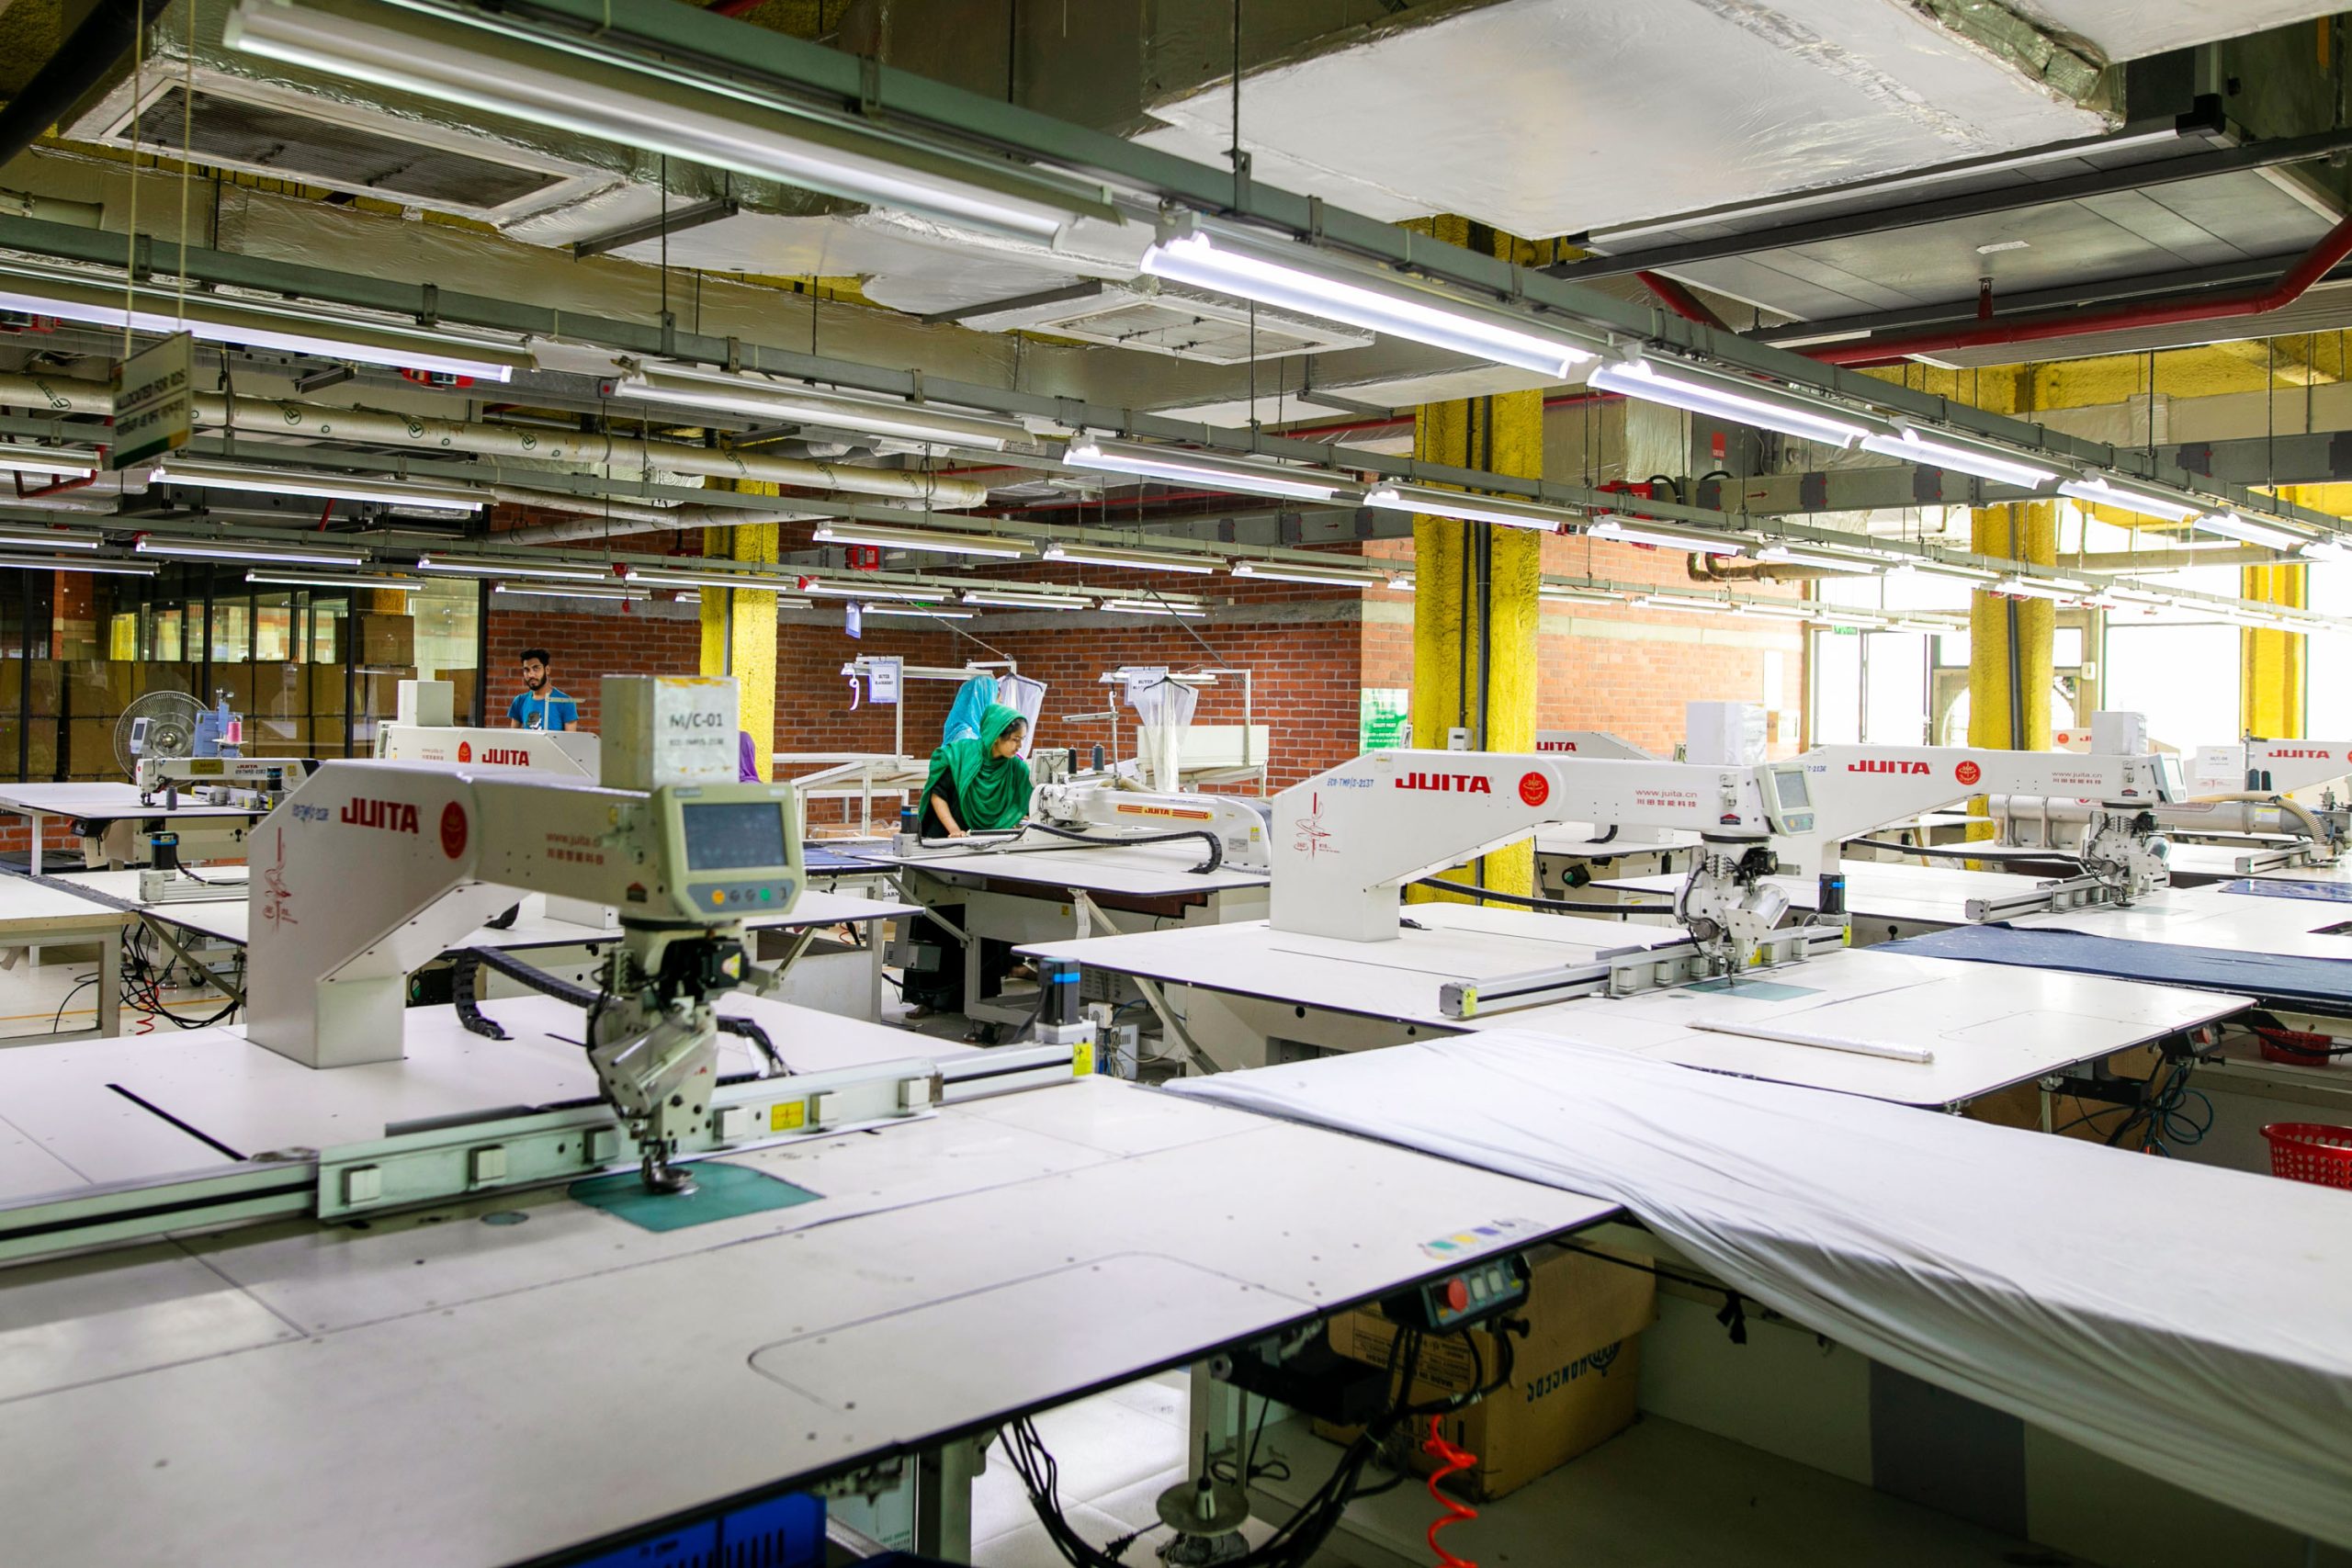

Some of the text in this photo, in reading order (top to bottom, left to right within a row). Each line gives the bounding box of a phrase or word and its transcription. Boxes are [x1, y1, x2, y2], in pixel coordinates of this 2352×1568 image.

[670, 713, 723, 729] M/C-01
[1536, 741, 1577, 751] UITA
[481, 749, 530, 766] JUITA
[2267, 749, 2330, 759] JUITA
[1848, 760, 1930, 775] JUITA
[1395, 773, 1492, 794] JUITA
[1635, 790, 1698, 798] www.juita.cn
[341, 797, 420, 834] JUITA
[1145, 807, 1170, 816] JUITA
